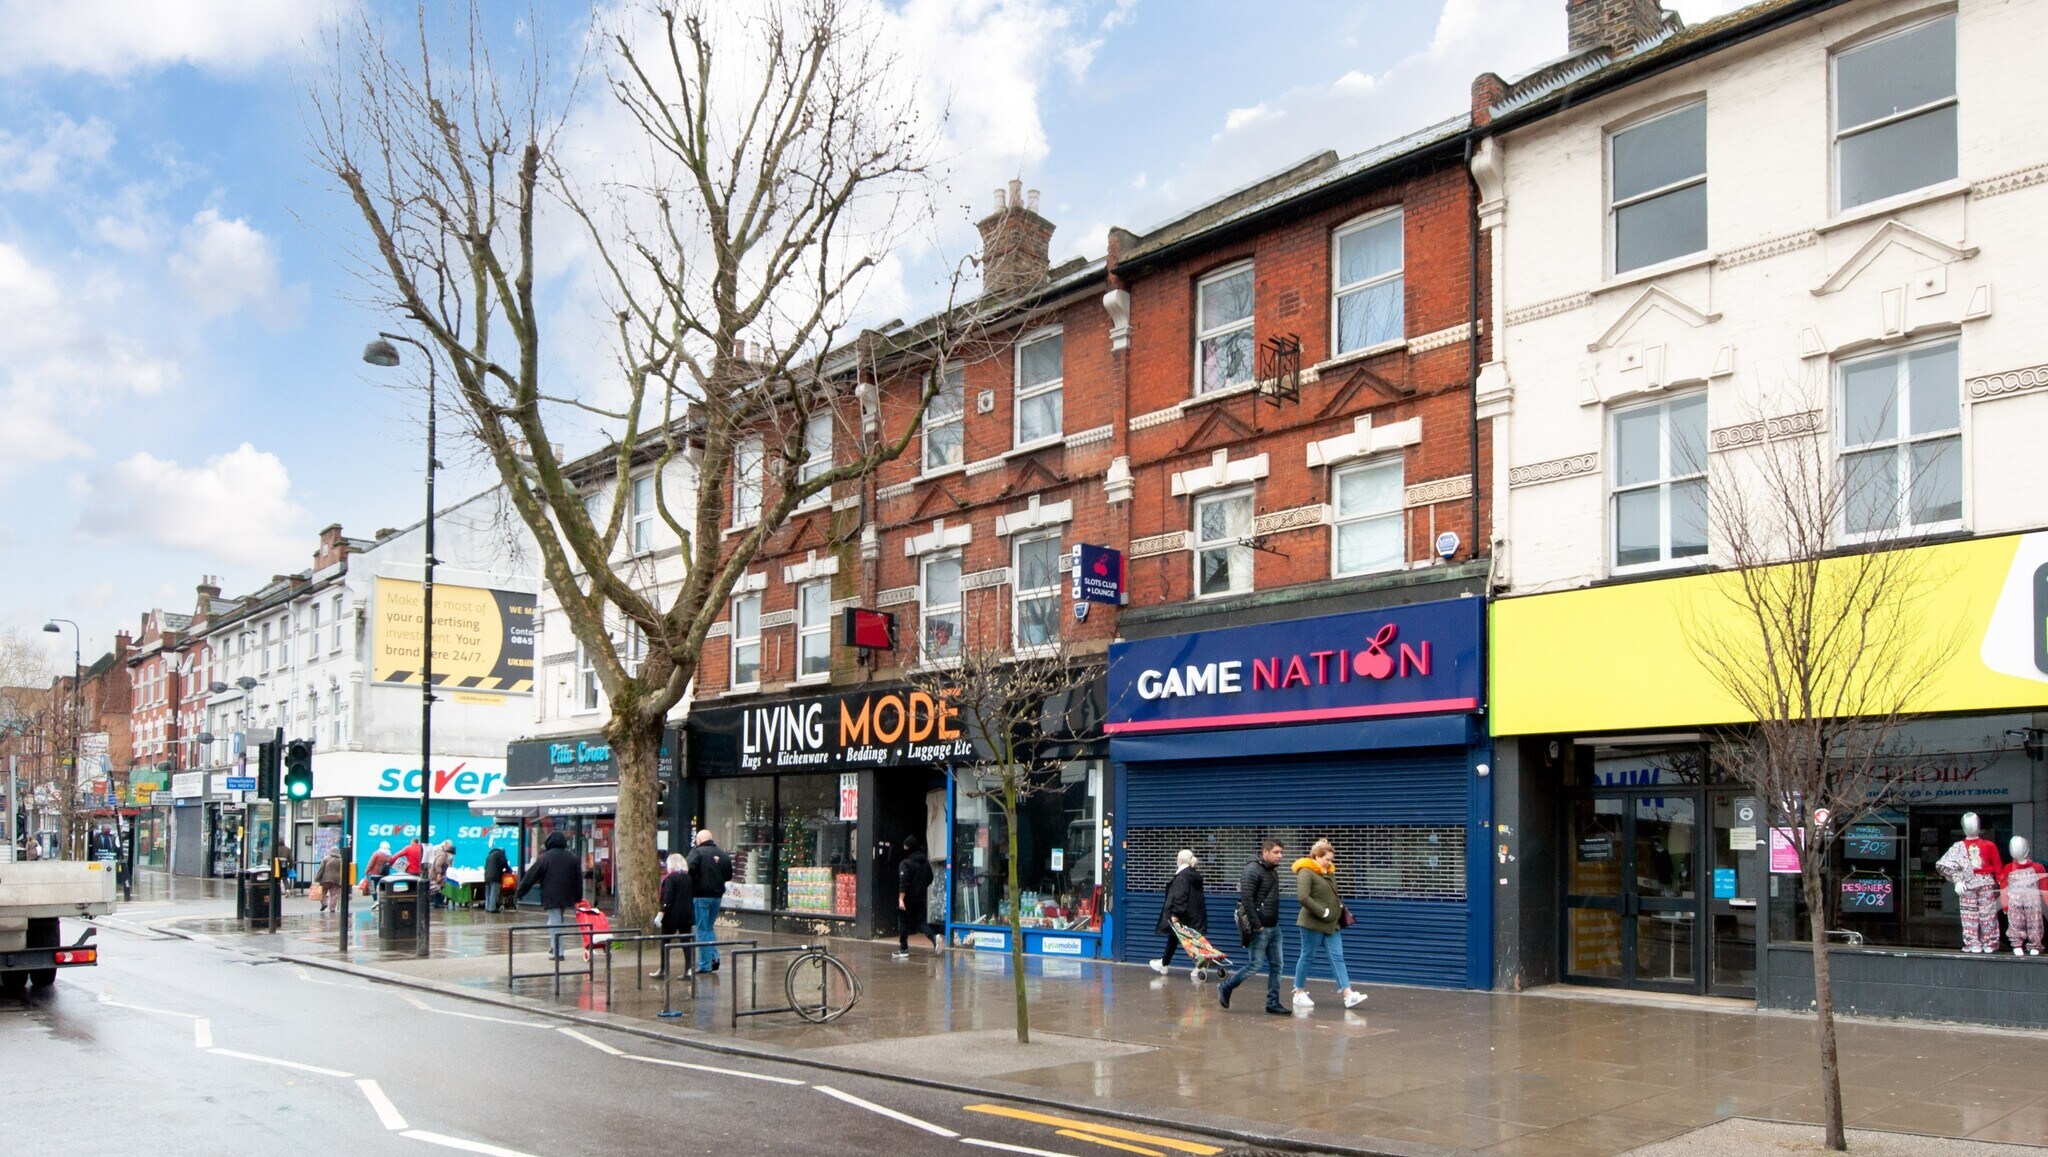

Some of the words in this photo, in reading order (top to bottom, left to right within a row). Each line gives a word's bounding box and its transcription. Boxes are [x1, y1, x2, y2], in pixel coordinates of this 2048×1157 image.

[1084, 577, 1101, 587] SLOTS
[1102, 580, 1118, 590] CLUB
[1091, 587, 1115, 598] LOUNGE
[387, 593, 419, 606] Make
[443, 600, 472, 612] most
[475, 602, 488, 616] of
[509, 606, 523, 614] WE
[386, 612, 413, 624] your
[416, 615, 480, 632] avertising
[386, 629, 452, 643] investent.
[456, 634, 481, 646] Your
[511, 636, 533, 645] 0845
[385, 644, 420, 658] brand
[430, 650, 449, 660] ere
[452, 650, 485, 663] 24/7.
[1137, 661, 1242, 700] GAME
[742, 702, 824, 753] LIVING
[840, 687, 963, 747] MODE
[742, 754, 762, 770] Rugs
[777, 750, 829, 766] Kitchenware
[846, 747, 888, 763] Beddings
[907, 742, 951, 761] Luggage
[953, 740, 972, 756] Etc
[378, 762, 508, 795] saver
[1841, 883, 1892, 894] DESIGNERS
[1849, 892, 1887, 906] -70%
[1043, 941, 1079, 951] Lycamobile
